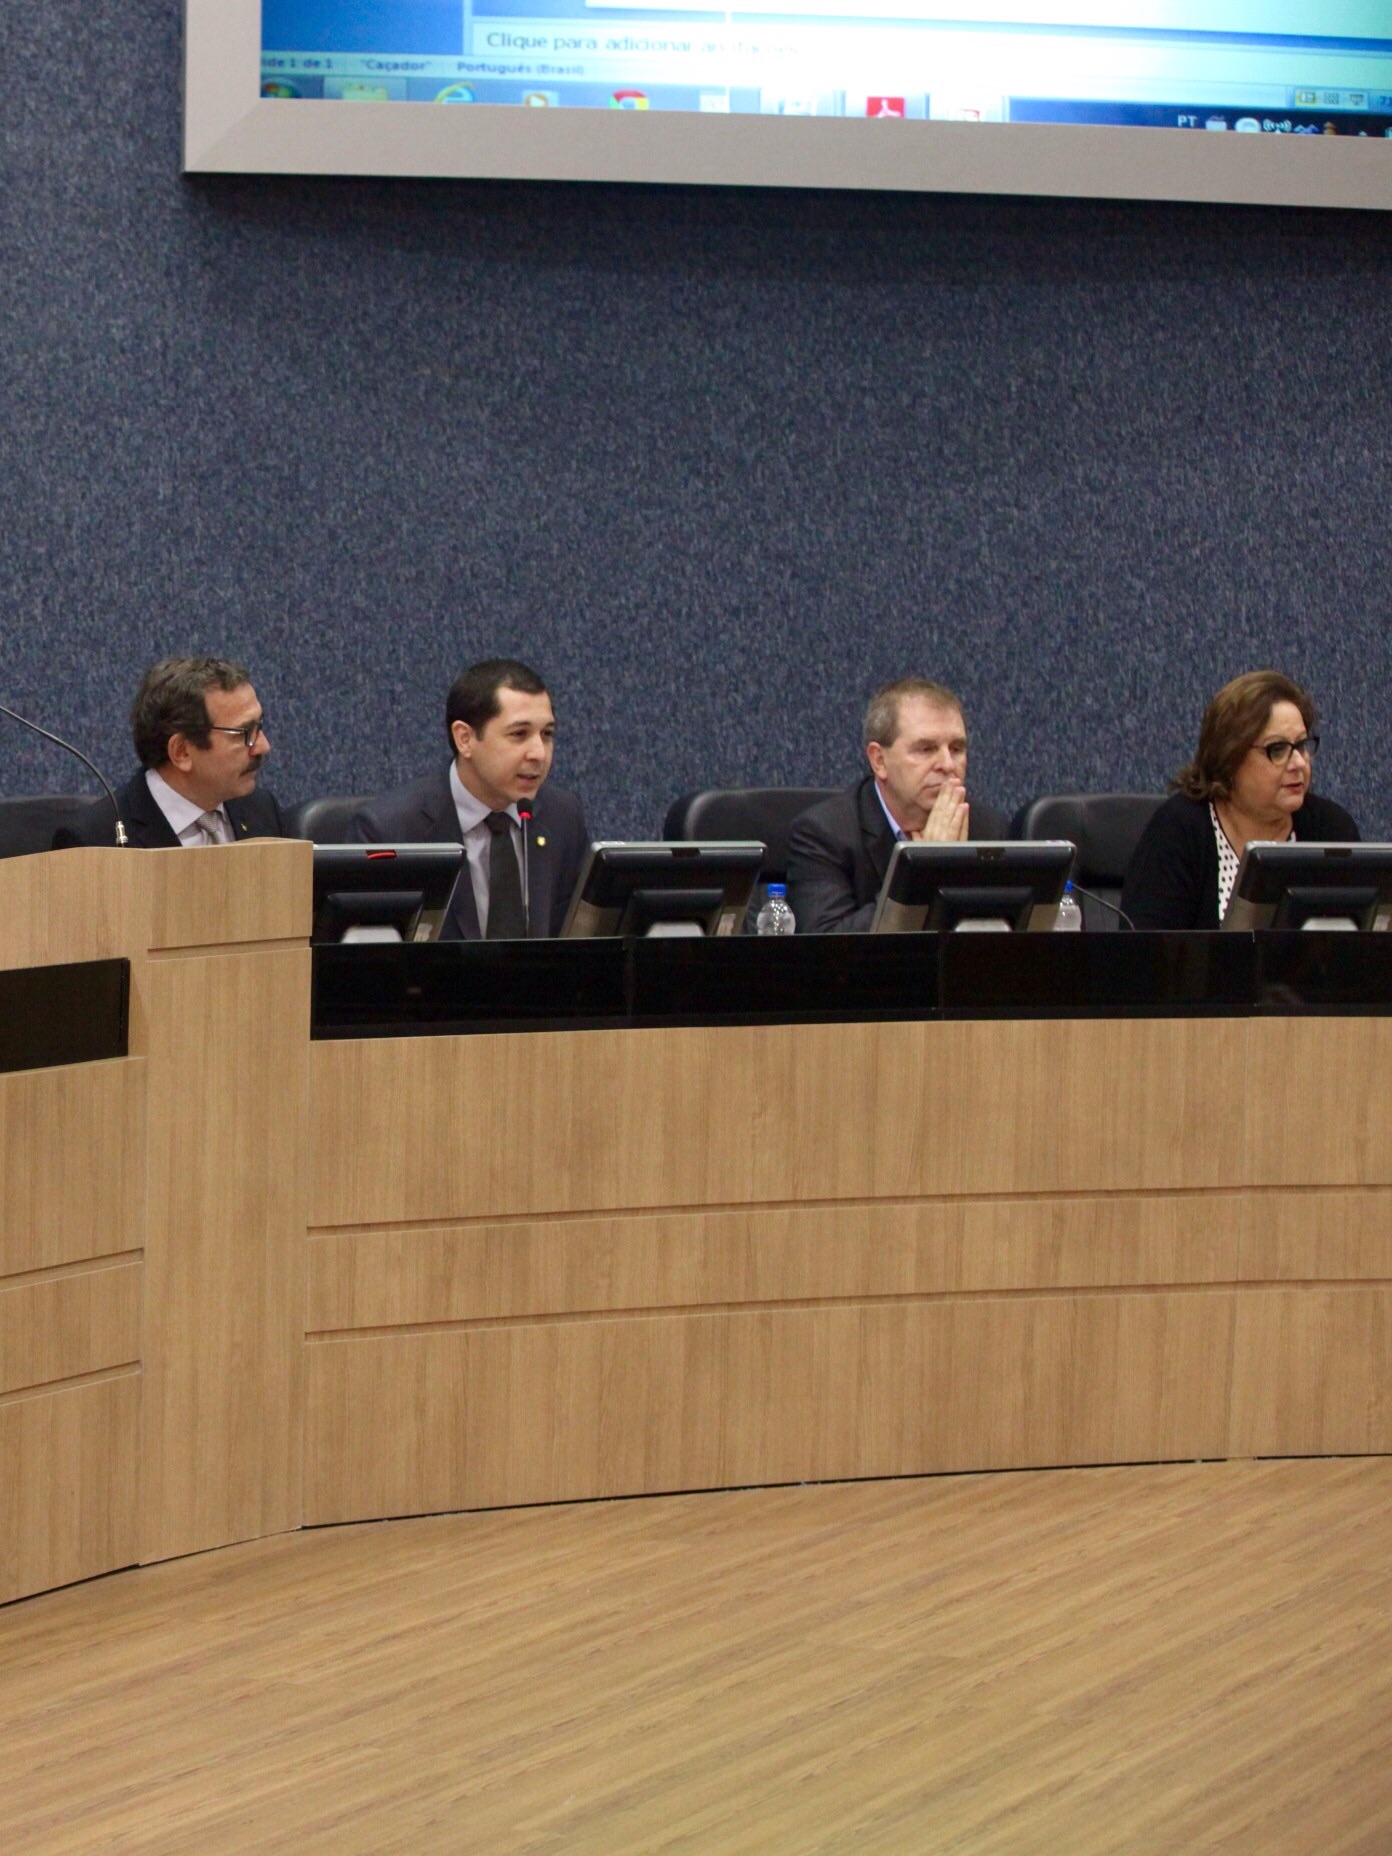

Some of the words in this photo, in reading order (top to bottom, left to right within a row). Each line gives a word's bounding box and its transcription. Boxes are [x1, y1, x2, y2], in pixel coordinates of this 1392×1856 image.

[486, 31, 548, 50] Clique
[553, 36, 598, 51] para
[605, 36, 692, 52] adicionar
[302, 58, 321, 69] de
[1176, 114, 1198, 128] PT
